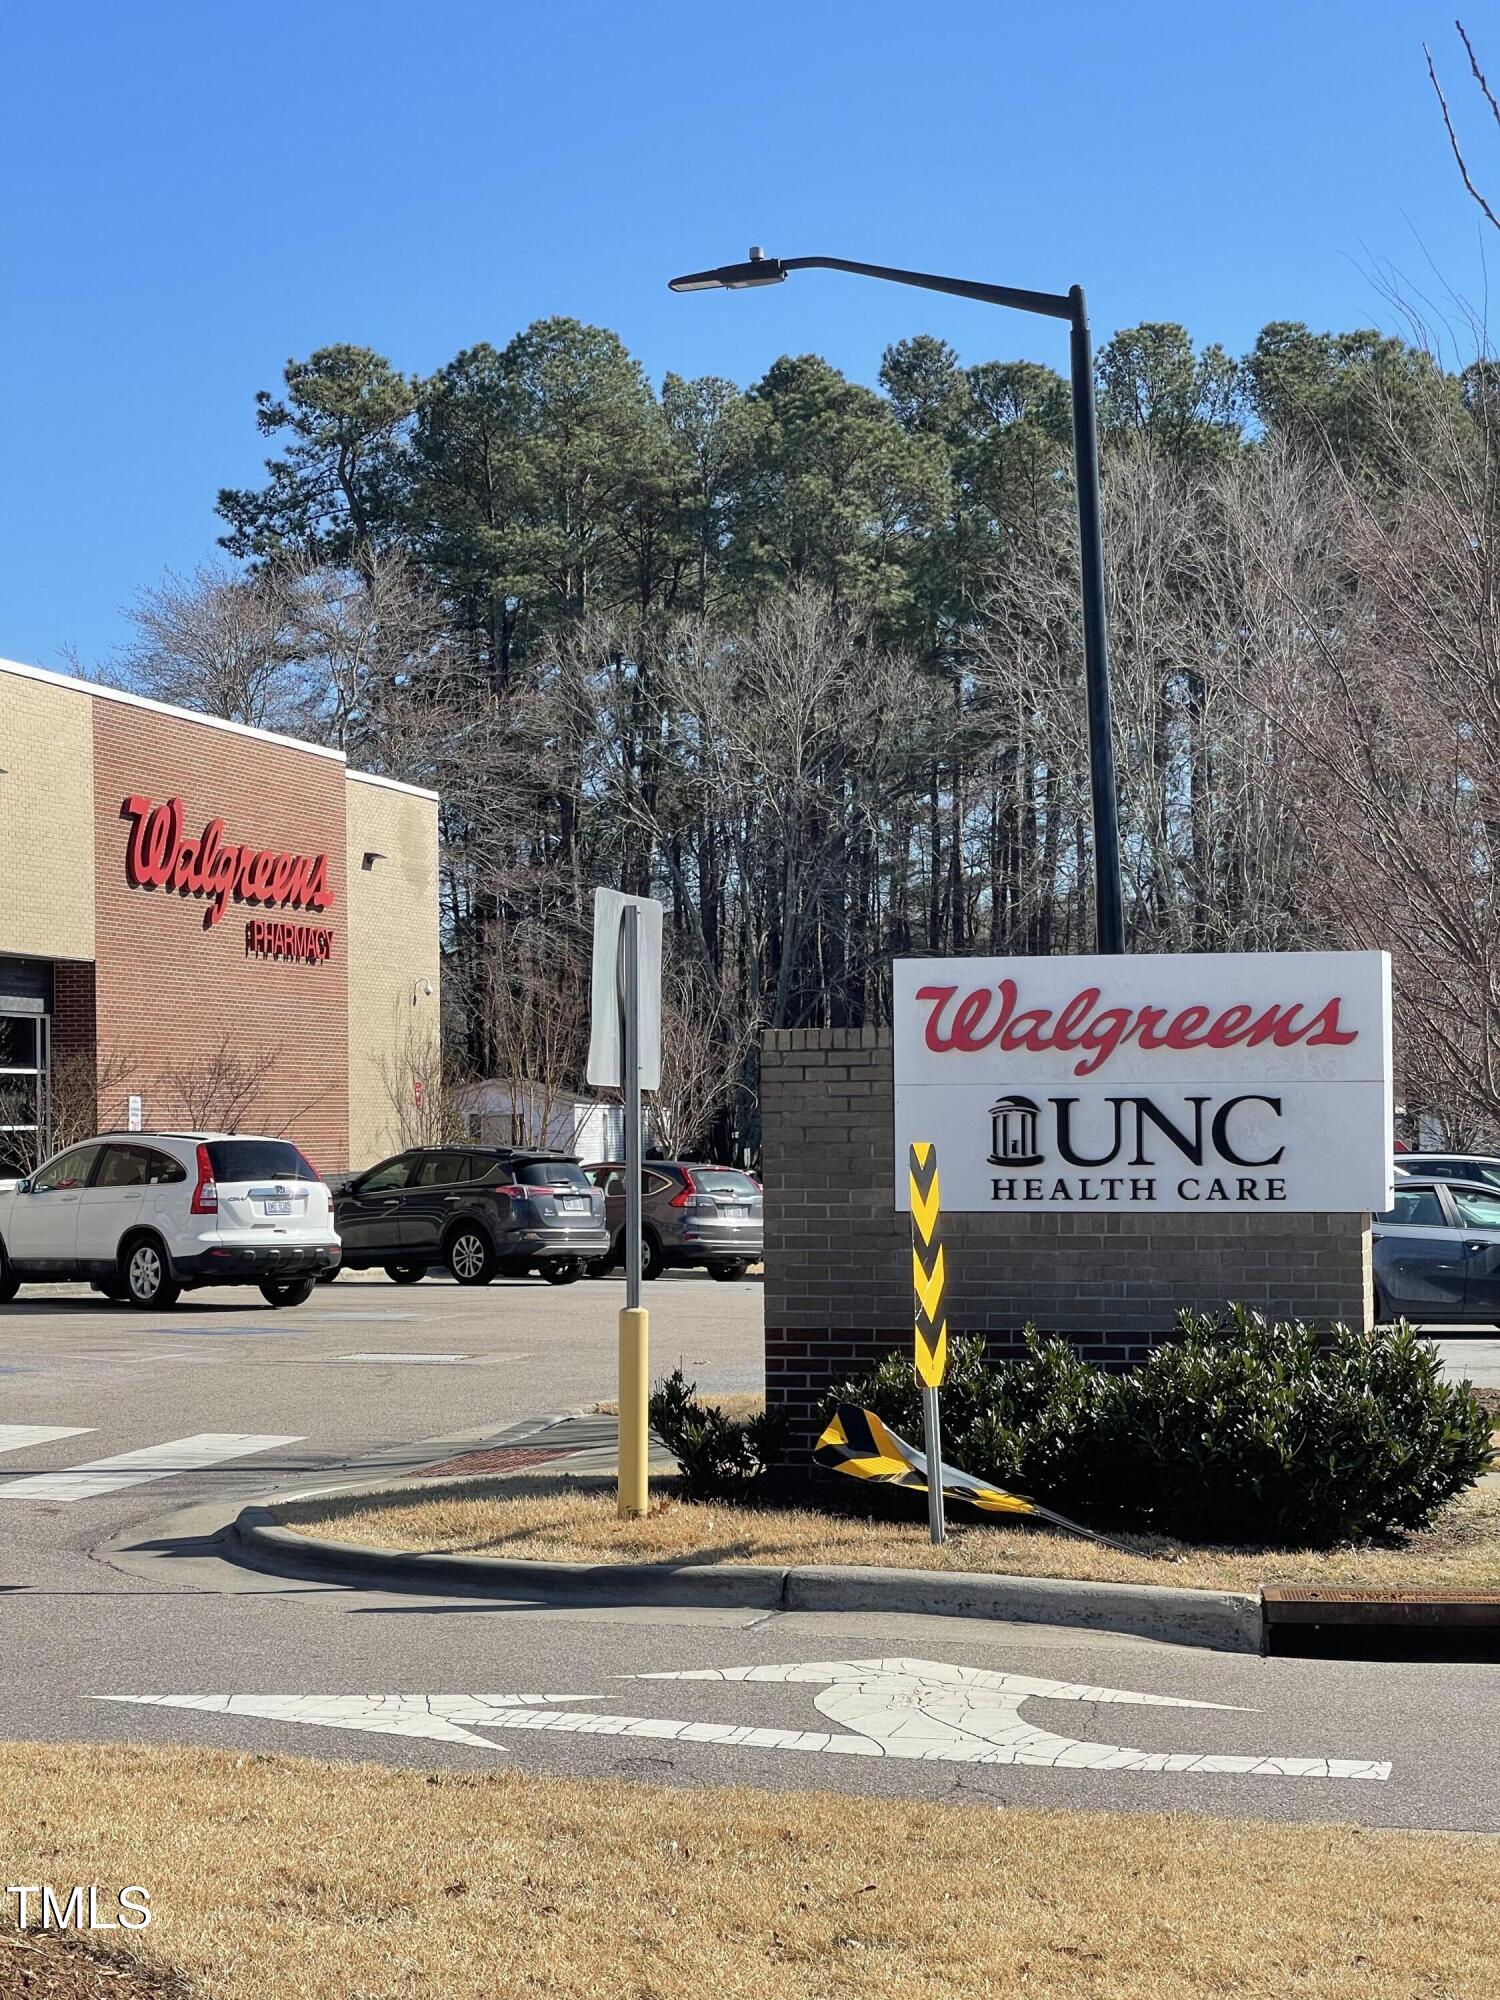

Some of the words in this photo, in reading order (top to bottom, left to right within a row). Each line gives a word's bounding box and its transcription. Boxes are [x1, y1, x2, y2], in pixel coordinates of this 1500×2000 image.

[121, 795, 334, 927] Walgreens
[252, 919, 335, 960] PHARMACY
[915, 979, 1358, 1076] Walgreens
[1047, 1094, 1285, 1167] UNC
[991, 1178, 1157, 1201] HEALTH
[1177, 1178, 1287, 1201] CARE
